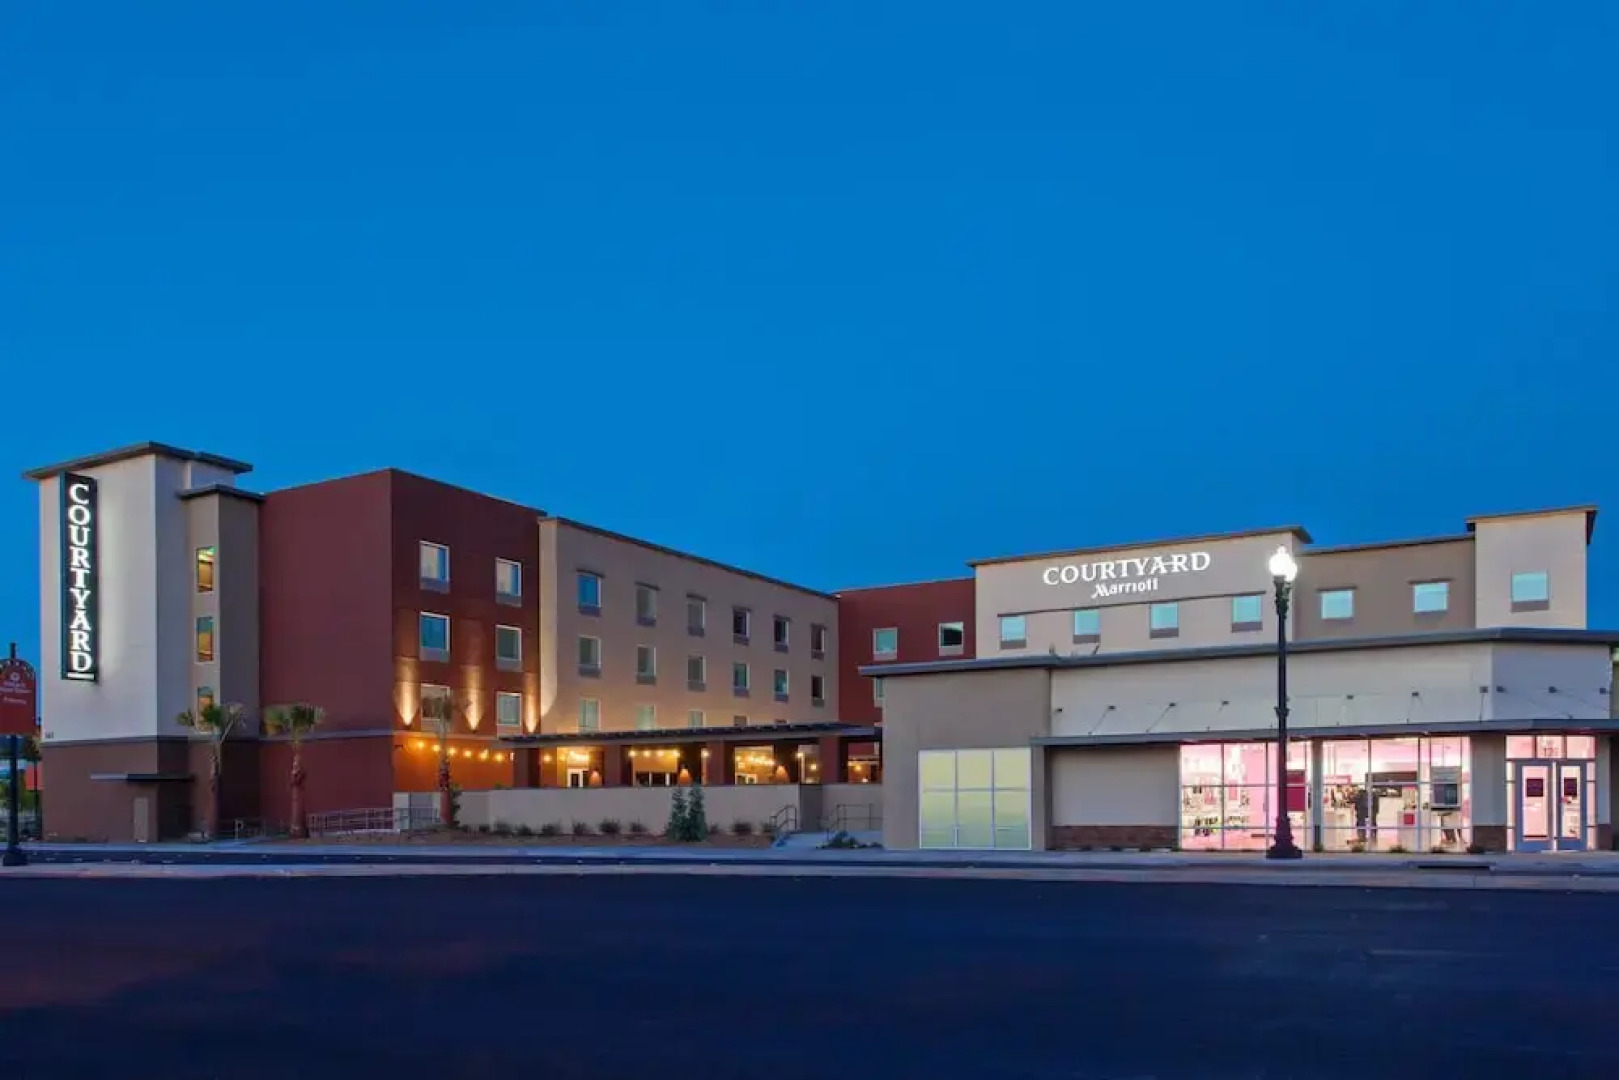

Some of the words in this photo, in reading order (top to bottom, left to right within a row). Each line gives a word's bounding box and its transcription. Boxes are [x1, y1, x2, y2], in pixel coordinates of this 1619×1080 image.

[68, 483, 92, 672] COURTYARD
[1043, 551, 1211, 586] COURTYARD
[1091, 577, 1159, 599] Marriott
